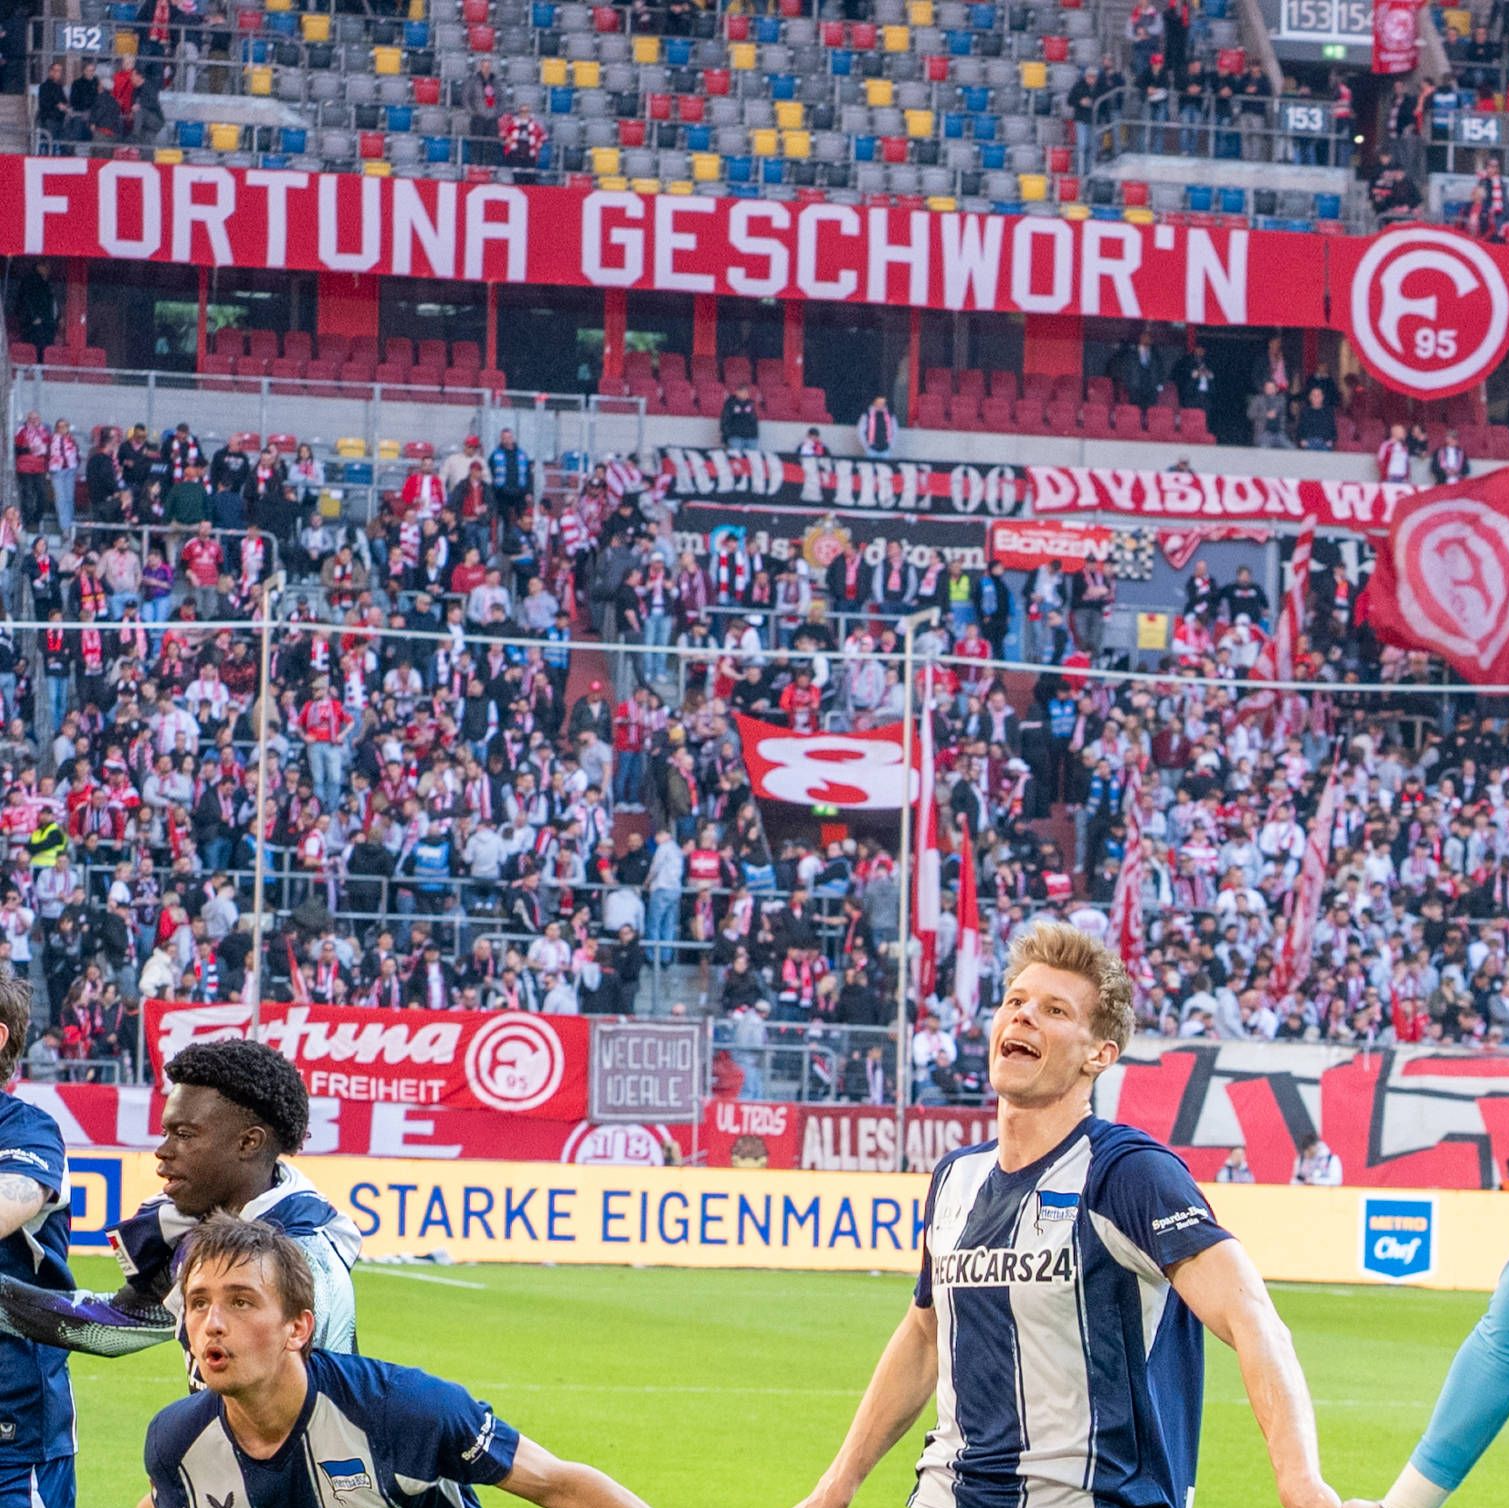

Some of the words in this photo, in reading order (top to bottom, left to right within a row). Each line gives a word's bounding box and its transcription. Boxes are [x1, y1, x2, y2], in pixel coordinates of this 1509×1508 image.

[1288, 2, 1331, 30] 153
[63, 26, 102, 49] 152
[1287, 106, 1323, 130] 153
[1462, 118, 1497, 141] 154
[25, 157, 528, 283] FORTUNA
[582, 192, 1248, 325] GESCHWOR'N
[1413, 329, 1456, 359] 95
[672, 449, 784, 496] RED
[800, 456, 932, 511] FIRE
[949, 461, 1017, 516] 06
[1034, 465, 1305, 516] DIVISION
[757, 737, 920, 809] 8
[602, 1038, 692, 1073] VECCHIO
[311, 1071, 447, 1103] FREIHEIT
[606, 1076, 685, 1108] IDEALE
[803, 1113, 898, 1172] ALLES
[350, 1181, 578, 1243] STARKE
